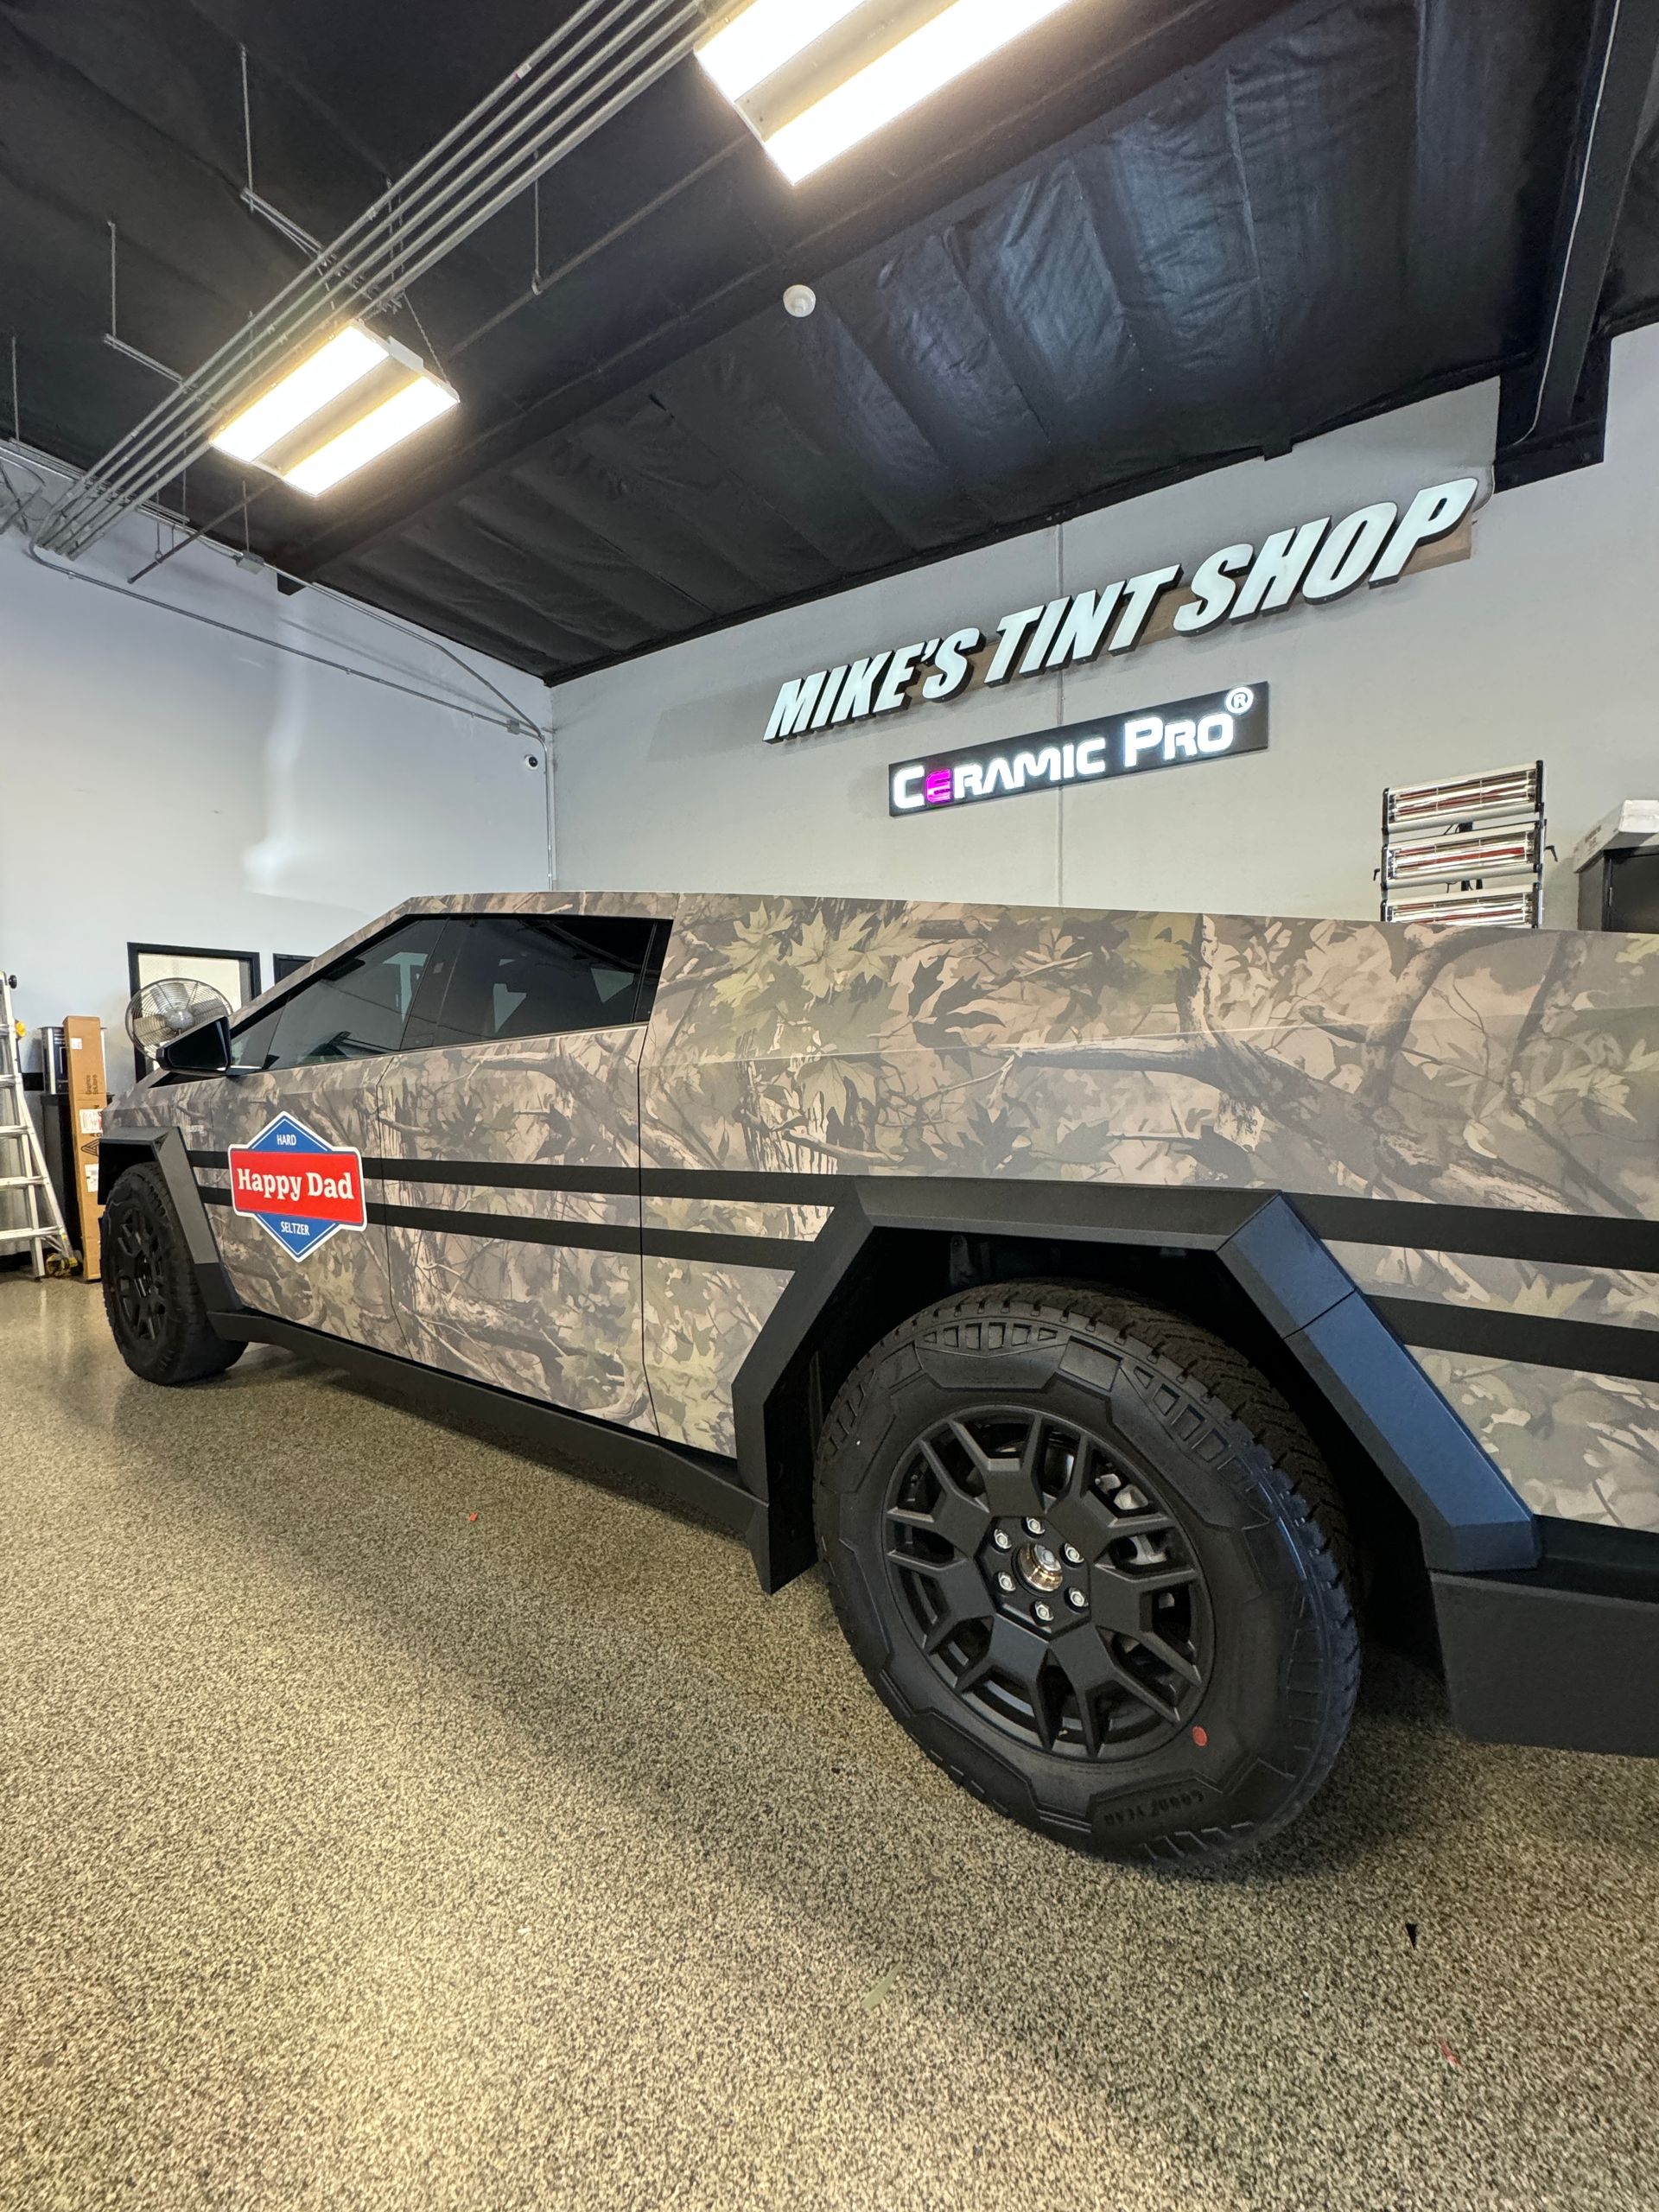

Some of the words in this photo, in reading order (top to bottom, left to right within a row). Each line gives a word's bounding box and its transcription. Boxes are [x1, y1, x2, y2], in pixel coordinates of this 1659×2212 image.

[762, 626, 983, 744] MIKE'S
[983, 563, 1184, 688] TINT
[1173, 477, 1479, 638] SHOP
[893, 735, 1107, 810] CERAMIC
[276, 1134, 297, 1147] HARD
[237, 1167, 302, 1202] Happy
[305, 1172, 355, 1200] Dad
[280, 1220, 310, 1236] SELTZER
